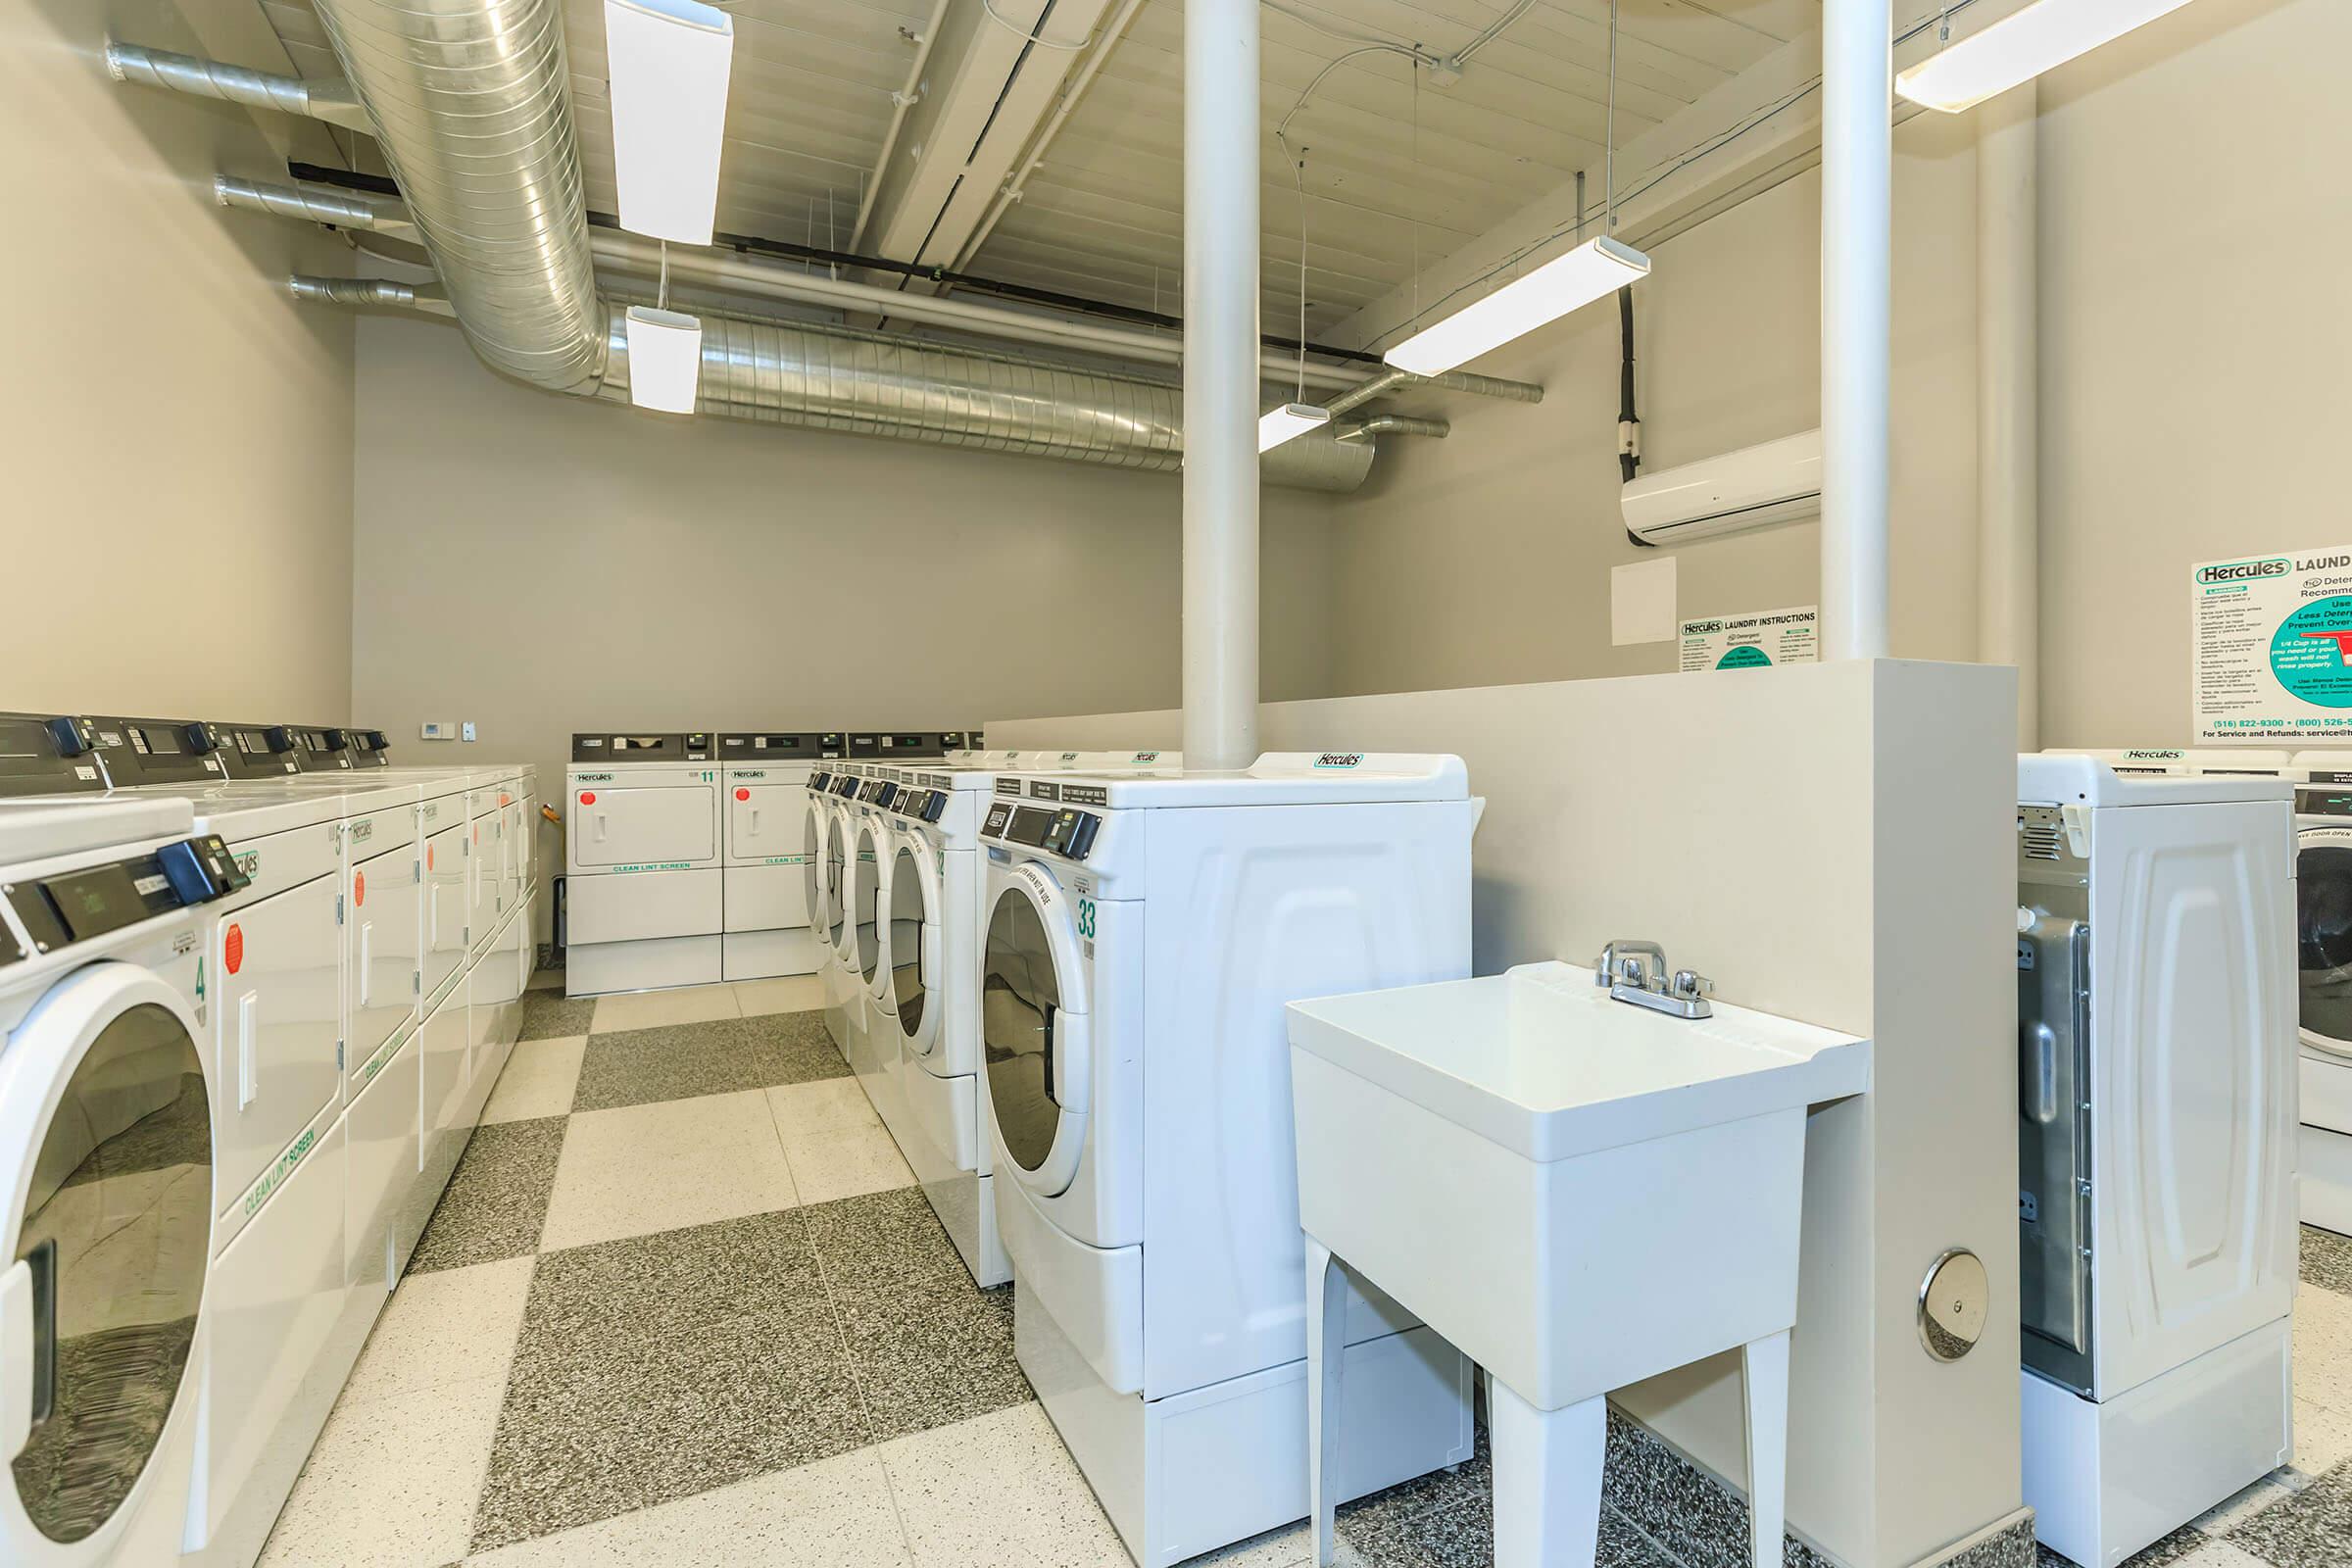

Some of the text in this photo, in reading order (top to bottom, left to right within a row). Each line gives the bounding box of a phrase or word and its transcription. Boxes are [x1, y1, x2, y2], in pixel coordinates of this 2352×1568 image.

[2205, 562, 2284, 581] Hercules
[1685, 612, 1815, 634] Hercules LAUNDRY INSTRUCTIONS
[2214, 720, 2237, 729] (516)
[2295, 718, 2322, 727] (800)
[1317, 752, 1361, 766] Hercules
[2128, 750, 2180, 759] Hercules
[578, 773, 612, 782] Hercules
[701, 771, 714, 782] 11
[335, 823, 341, 856] 5
[1027, 870, 1037, 883] WHEN
[1034, 879, 1043, 891] NOT
[1041, 893, 1052, 906] USE
[1078, 899, 1097, 939] 33
[195, 956, 205, 1002] 4
[245, 1126, 315, 1216] CLEAN LINT SCREEN
